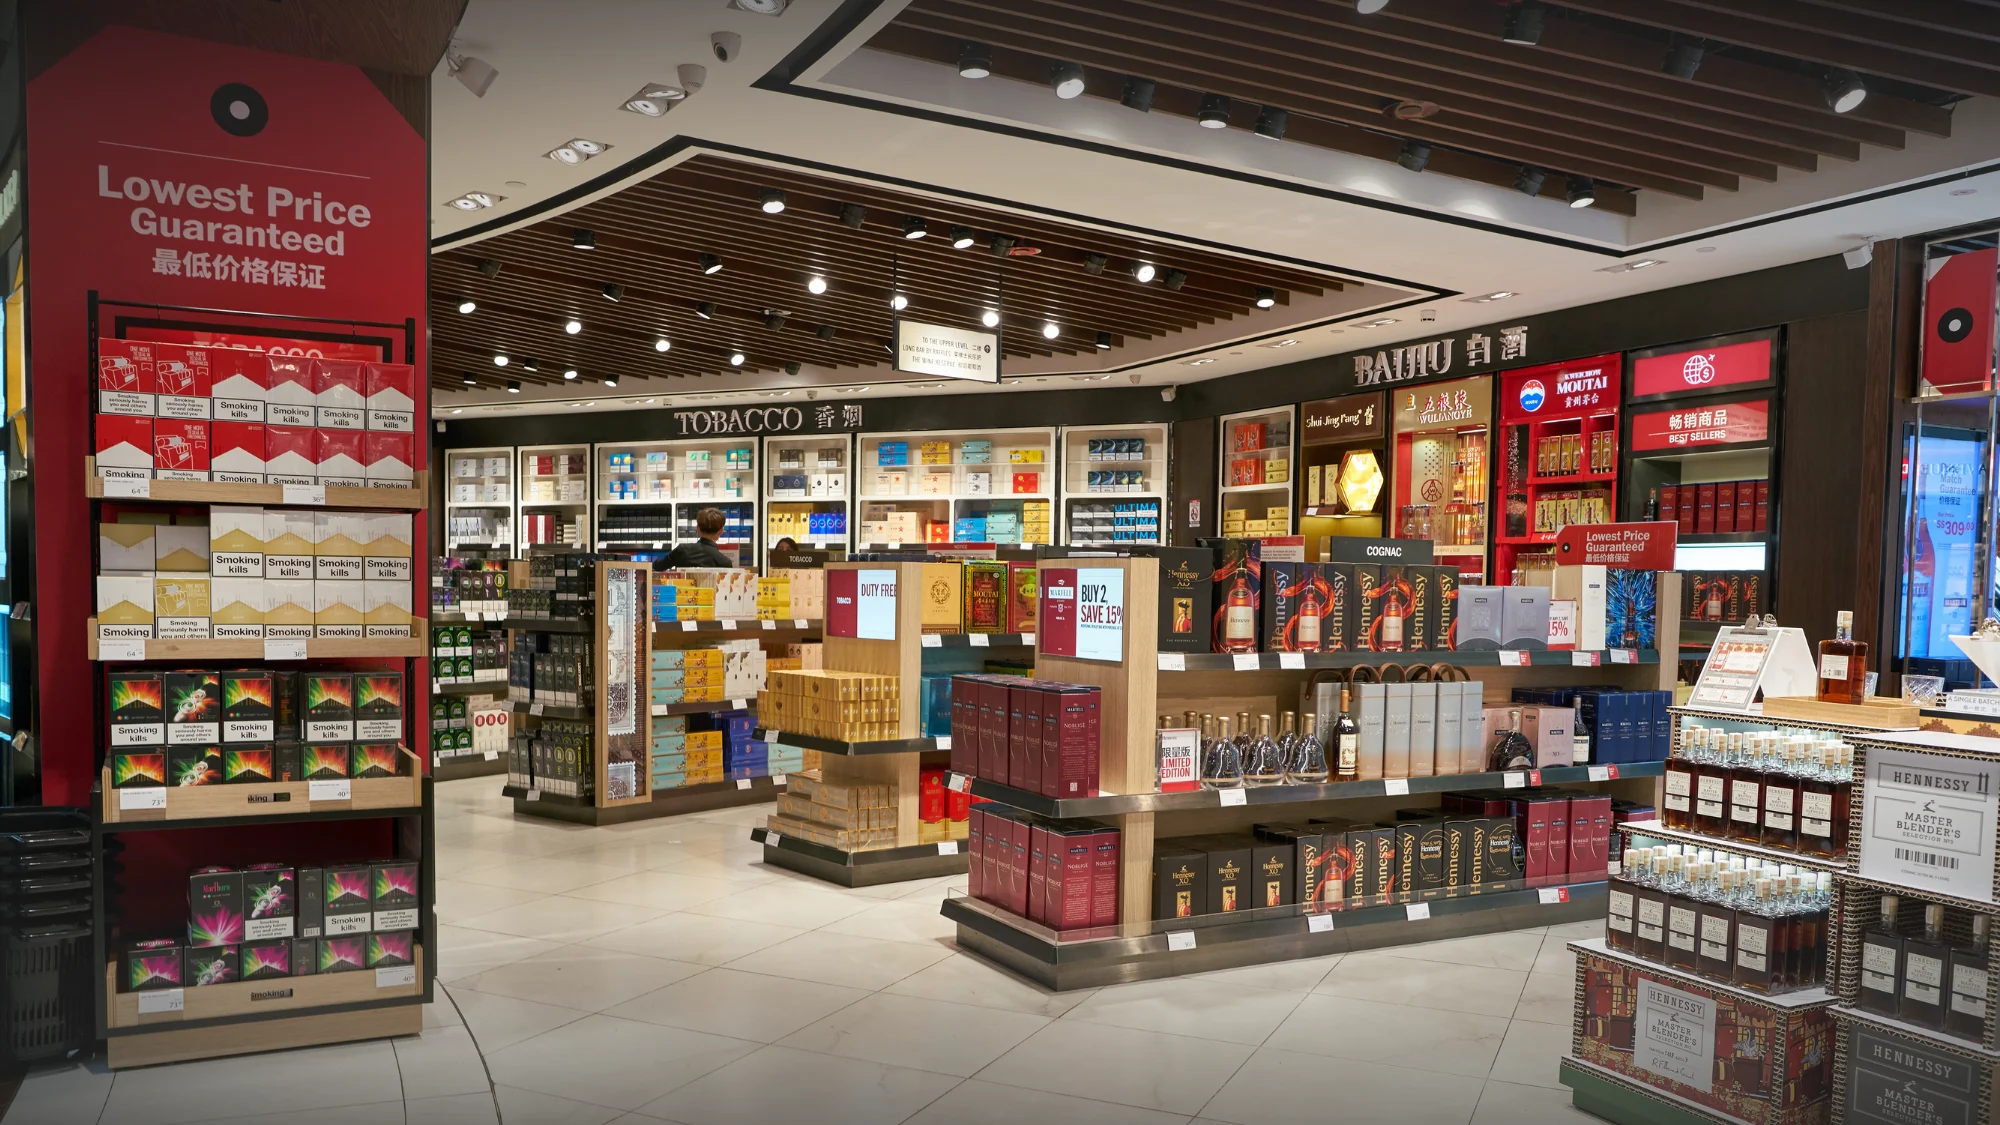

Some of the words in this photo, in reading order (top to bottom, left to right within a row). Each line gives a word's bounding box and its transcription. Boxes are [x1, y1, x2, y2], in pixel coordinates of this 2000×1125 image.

[98, 165, 254, 213] Lowest
[267, 187, 371, 228] Price
[131, 207, 345, 257] Guaranteed
[151, 247, 326, 290] 最低价格保证
[902, 344, 915, 352] LONG
[933, 348, 951, 356] RAFFLES
[955, 342, 968, 350] LEVEL
[1466, 325, 1528, 367] 白酒
[1353, 338, 1455, 387] BAIJIU
[1556, 376, 1608, 395] MOUTAI
[220, 401, 258, 412] Smoking
[231, 408, 248, 418] kills
[273, 407, 310, 418] Smoking
[324, 410, 360, 420] Smoking
[374, 413, 408, 423] Smoking
[814, 404, 863, 428] 香烟
[283, 415, 300, 424] kills
[334, 418, 350, 427] kills
[673, 407, 803, 435] TOBACCO
[1306, 414, 1322, 428] Shui
[1323, 415, 1339, 428] Jing
[1669, 409, 1727, 431] 畅销商品
[384, 421, 399, 430] kills
[1669, 433, 1689, 444] BEST
[1690, 430, 1726, 442] SELLERS
[220, 475, 258, 484] Smoking
[274, 478, 310, 486] Smoking
[324, 480, 360, 488] Smoking
[1941, 475, 1962, 484] Match
[1940, 484, 1976, 496] Guarantee
[1114, 502, 1158, 512] ULTIMA
[1114, 517, 1157, 526] ULTIMA
[1113, 531, 1157, 541] ULTIMA
[1586, 532, 1622, 542] Lowest
[1623, 530, 1650, 541] Price
[1366, 545, 1402, 558] COGNAC
[1586, 541, 1645, 552] Guaranteed
[216, 556, 260, 566] Smoking
[268, 558, 311, 569] Smoking
[1585, 553, 1630, 563] 最低价格保证
[228, 565, 248, 574] kills
[318, 559, 360, 570] Smoking
[367, 560, 408, 570] Smoking
[280, 568, 300, 577] kills
[330, 568, 350, 578] kills
[378, 569, 397, 578] kills
[861, 584, 878, 597] DUTY
[973, 590, 999, 598] MOUTAI
[1081, 584, 1100, 603] BUY
[1100, 584, 1108, 606] 2,
[1690, 574, 1702, 619] Hennessy
[1728, 574, 1740, 620] Hennessy
[1080, 604, 1104, 624] SAVE
[1106, 606, 1124, 625] 15%
[1272, 570, 1289, 650] Hennessy
[1328, 571, 1346, 649] Hennessy
[1357, 571, 1374, 650] Hennessy
[1410, 573, 1428, 650] Hennessy
[1437, 573, 1454, 650] Hennessy
[103, 628, 150, 638] Smoking
[216, 628, 260, 638] Smoking
[268, 628, 311, 638] Smoking
[320, 628, 360, 638] Smoking
[368, 628, 408, 638] Smoking
[1954, 696, 1976, 704] SINGLE
[1978, 698, 2000, 706] BATCH
[118, 726, 158, 735] Smoking
[230, 724, 268, 732] Smoking
[312, 724, 348, 732] Smoking
[130, 734, 148, 742] kills
[240, 732, 258, 740] kills
[1162, 746, 1191, 758] 限量版
[1162, 758, 1191, 769] LIMITED
[1162, 767, 1191, 778] EDITION
[1893, 771, 1970, 792] HENNESSY
[1905, 812, 1953, 828] MASTER
[1896, 820, 1961, 838] BLENDER'S
[1902, 831, 1941, 842] SELECTION
[1262, 862, 1284, 870] Hennessy
[1446, 828, 1462, 898] Hennessy
[1470, 826, 1484, 895] Hennessy
[1218, 866, 1240, 875] Hennessy
[1352, 839, 1366, 906] Hennessy
[1376, 837, 1390, 904] Hennessy
[1400, 832, 1414, 902] Hennessy
[1172, 872, 1195, 880] Hennessy
[1303, 844, 1316, 913] Hennessy
[331, 916, 366, 926] Smoking
[340, 924, 357, 932] kills
[1650, 990, 1702, 1015] HENNESSY
[1658, 1019, 1691, 1036] MASTER
[1652, 1025, 1697, 1046] BLENDER'S
[1656, 1034, 1683, 1047] SELECTION
[1874, 1044, 1952, 1078] HENNESSY
[1884, 1088, 1934, 1113] MASTER
[1876, 1096, 1943, 1125] BLENDER'S
[1882, 1108, 1920, 1125] SELECTION
